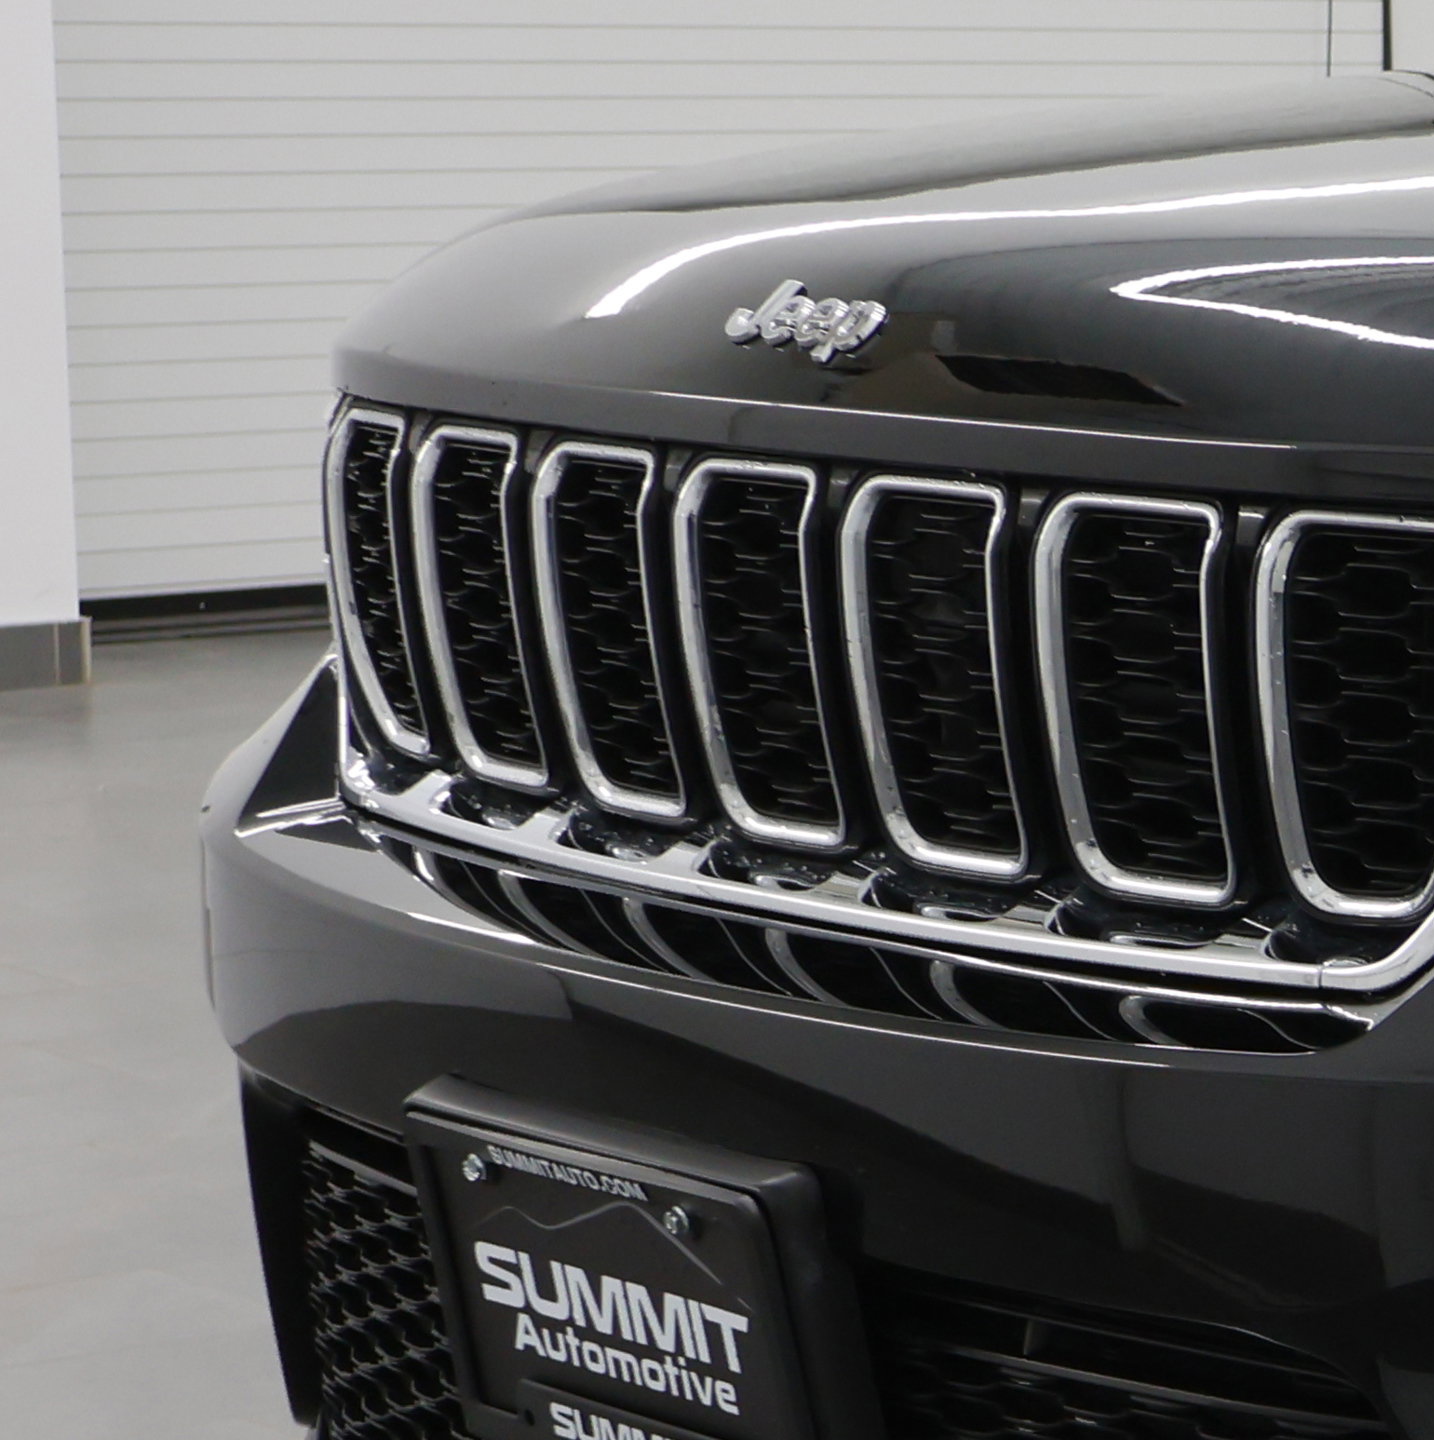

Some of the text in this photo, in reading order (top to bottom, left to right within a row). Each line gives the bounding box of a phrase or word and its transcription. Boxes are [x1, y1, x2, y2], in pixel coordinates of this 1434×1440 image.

[724, 279, 887, 364] Jeep
[487, 1144, 648, 1201] SUMMITAUTO.COM
[474, 1240, 749, 1374] SUMMIT
[515, 1313, 740, 1416] Automotive
